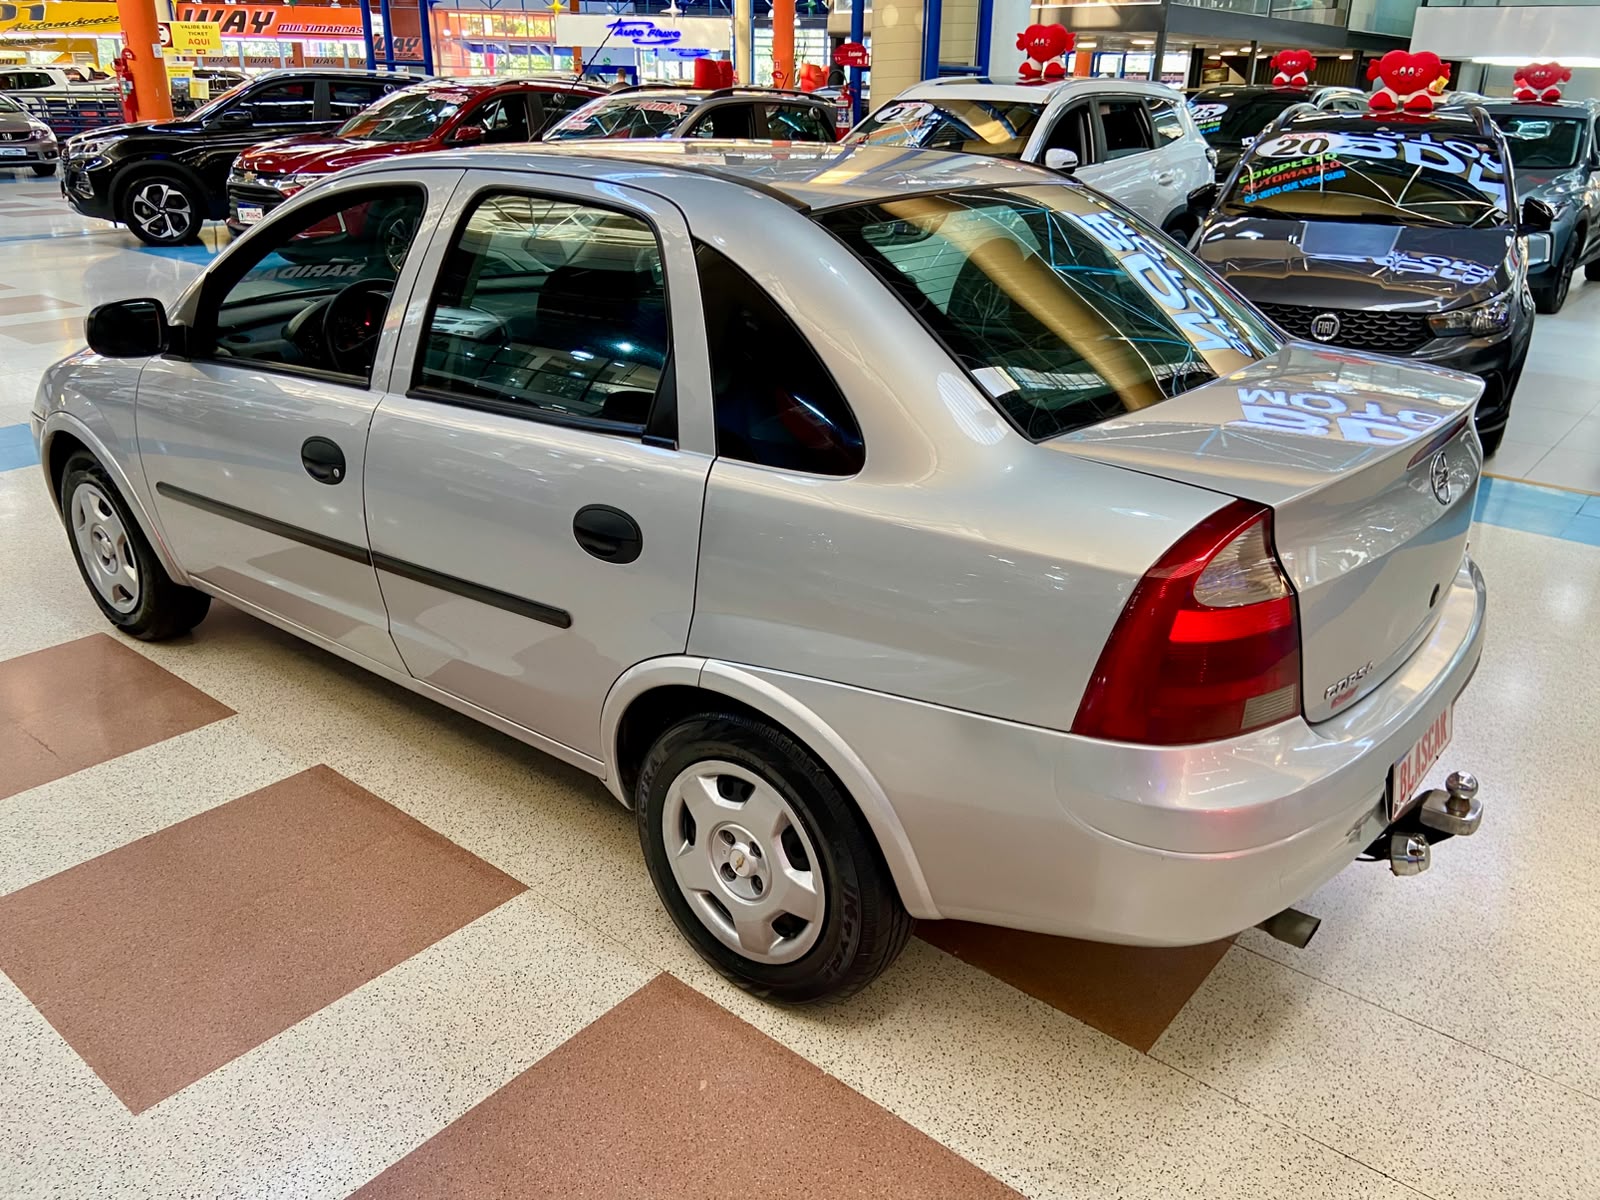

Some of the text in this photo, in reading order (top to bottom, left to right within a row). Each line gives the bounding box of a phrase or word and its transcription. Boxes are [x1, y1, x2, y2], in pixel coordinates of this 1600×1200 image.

[277, 24, 363, 34] MULTIMARCAS
[614, 28, 681, 38] Auto Fluxo
[1271, 138, 1329, 155] 20
[1239, 153, 1338, 183] COMPLETO
[1244, 194, 1257, 204] DO
[1282, 182, 1300, 192] QUE
[1317, 321, 1335, 334] FIAT
[1400, 709, 1447, 802] BLASCAR
